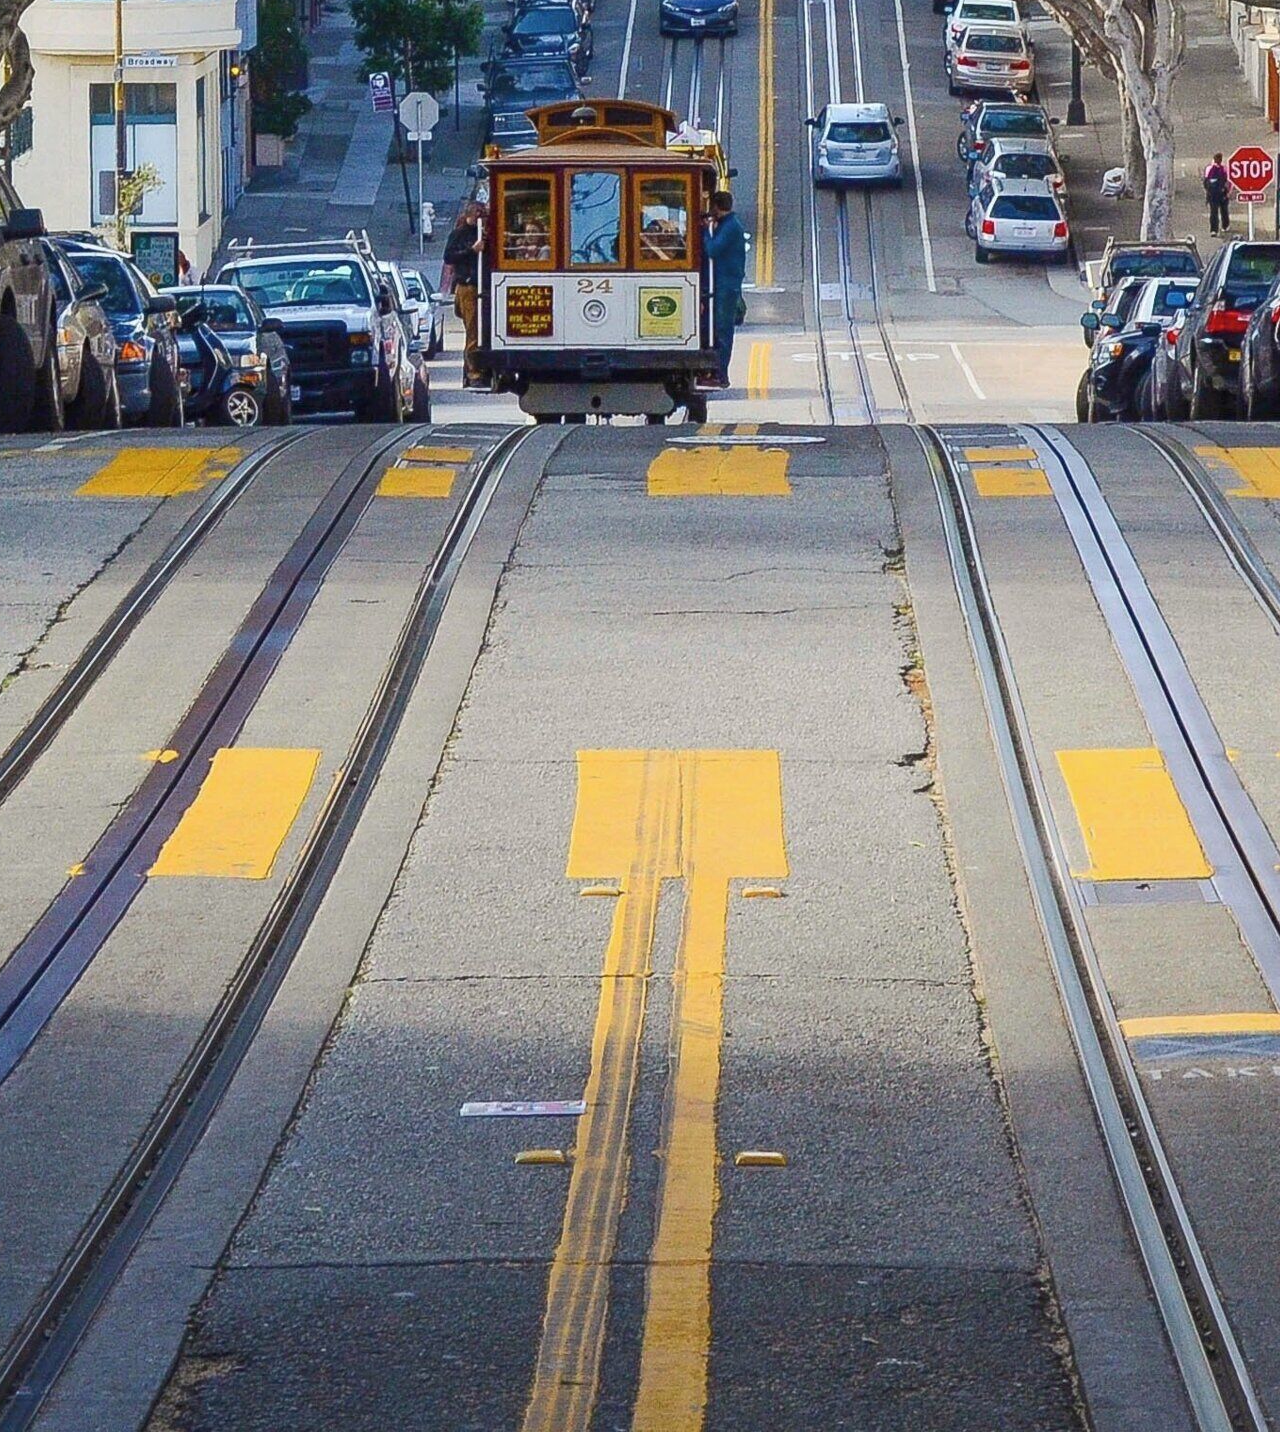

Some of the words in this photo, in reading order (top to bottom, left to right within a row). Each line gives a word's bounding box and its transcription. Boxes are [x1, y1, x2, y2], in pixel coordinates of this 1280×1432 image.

[128, 58, 174, 67] Broadway
[1231, 160, 1272, 179] STOP
[577, 278, 613, 294] 24
[791, 352, 940, 362] STOP
